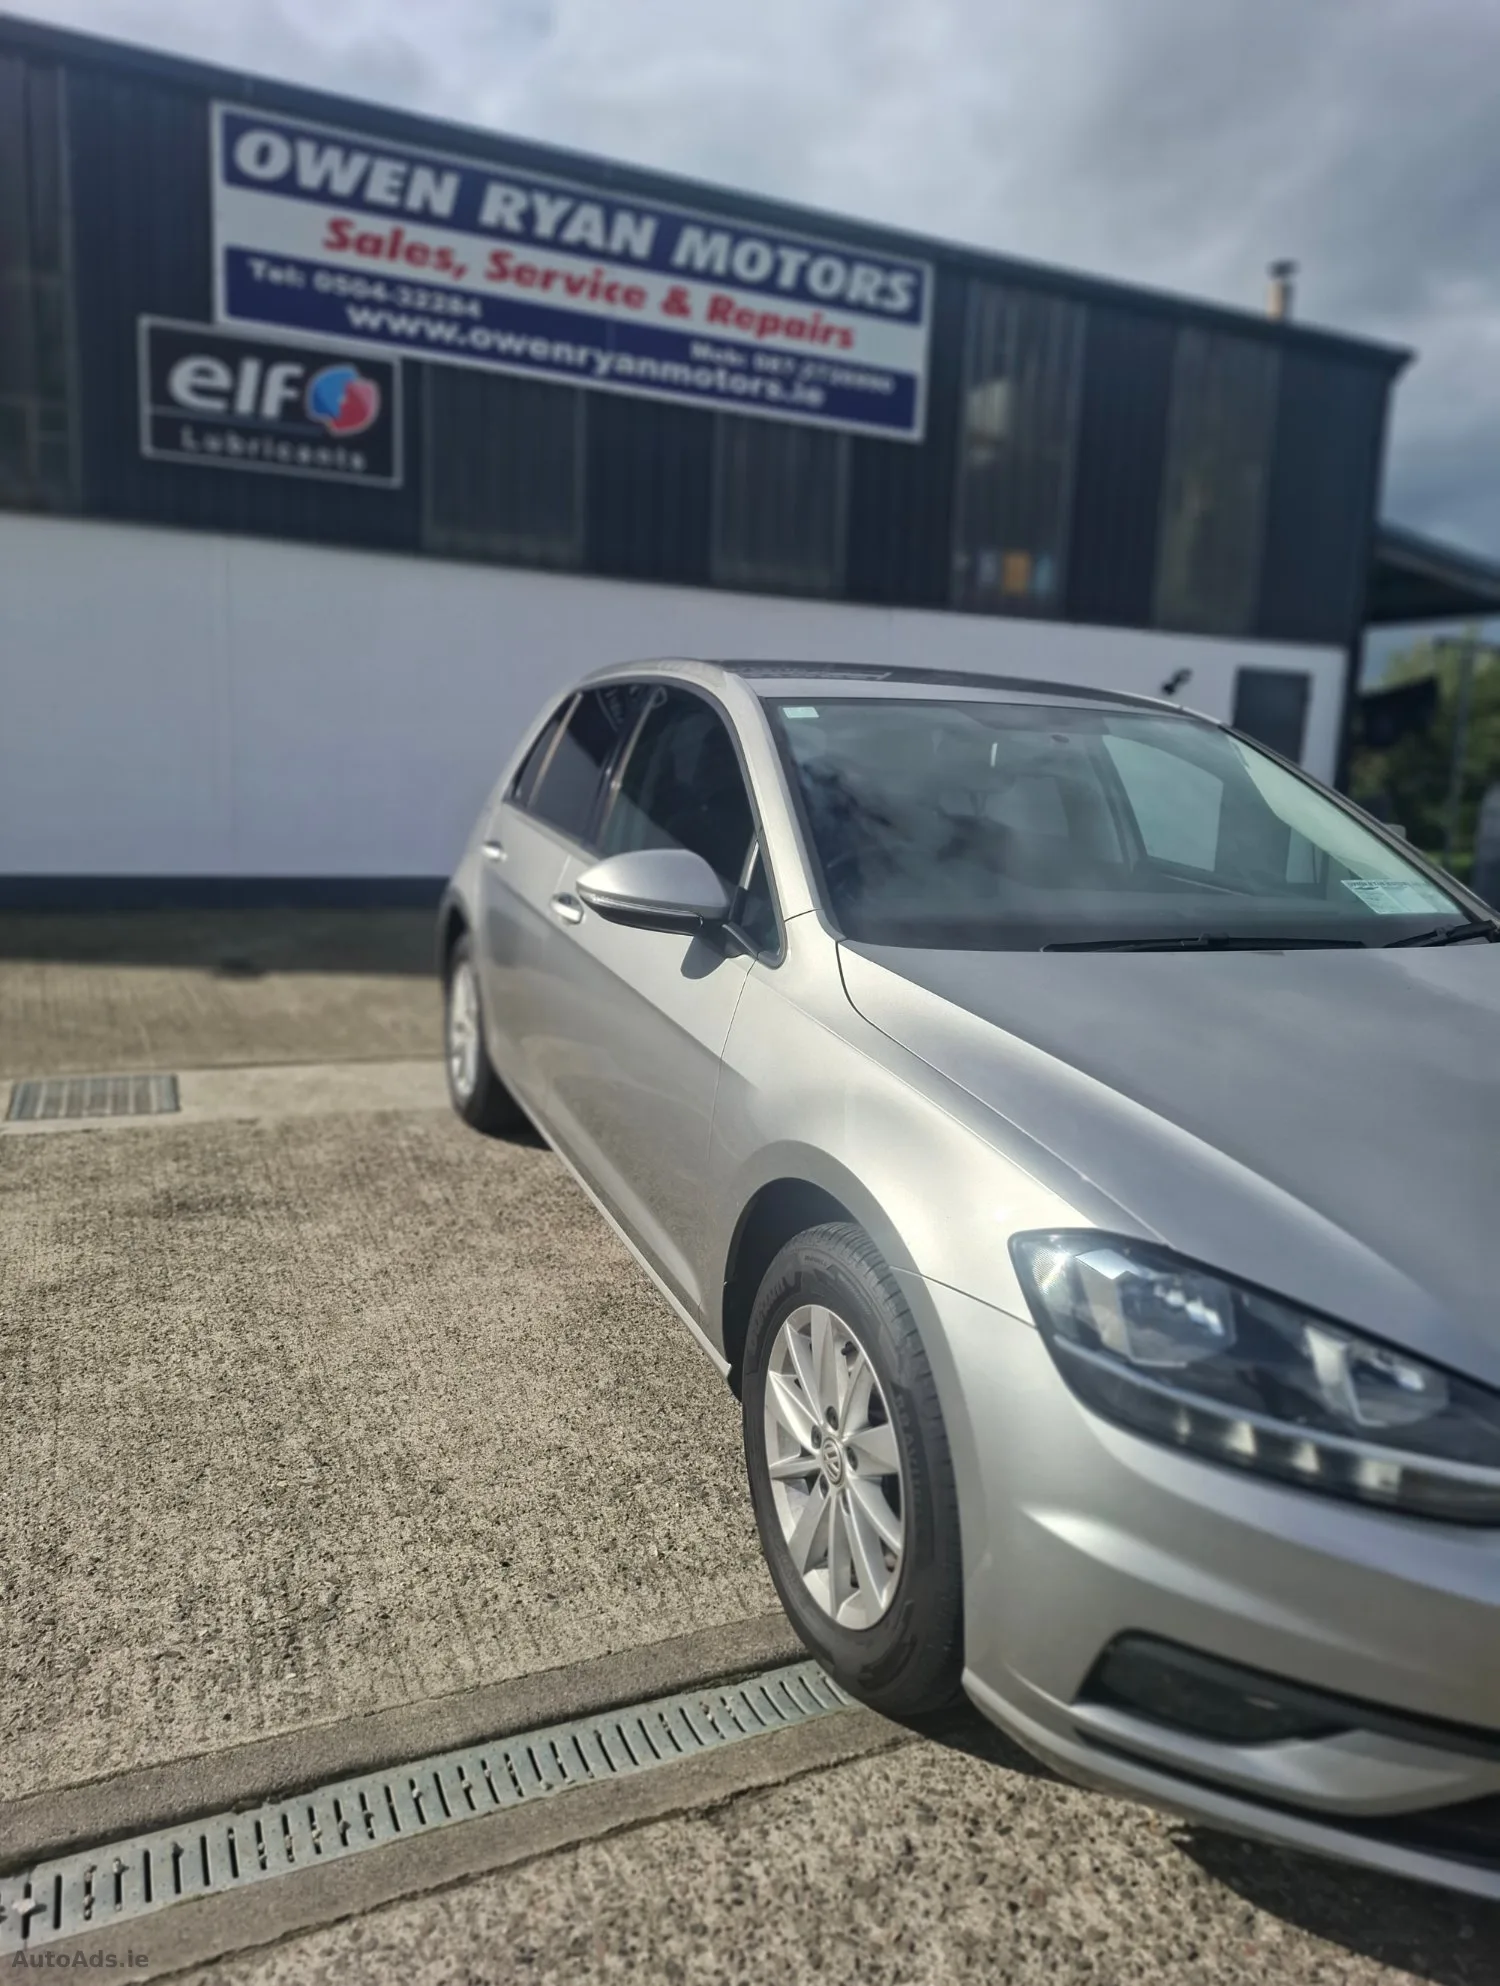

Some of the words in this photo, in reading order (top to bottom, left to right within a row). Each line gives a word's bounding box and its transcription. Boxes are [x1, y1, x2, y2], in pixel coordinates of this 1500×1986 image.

[232, 129, 460, 218] OWEN
[478, 182, 657, 259] RYAN
[671, 225, 917, 312] MOTORS
[248, 258, 306, 289] Tel:
[322, 217, 468, 280] Sales,
[484, 248, 647, 310] Service
[661, 286, 692, 318] &
[706, 293, 855, 349] Repairs
[168, 355, 305, 418] elf
[346, 304, 827, 408] www.owenryanmotors.ie
